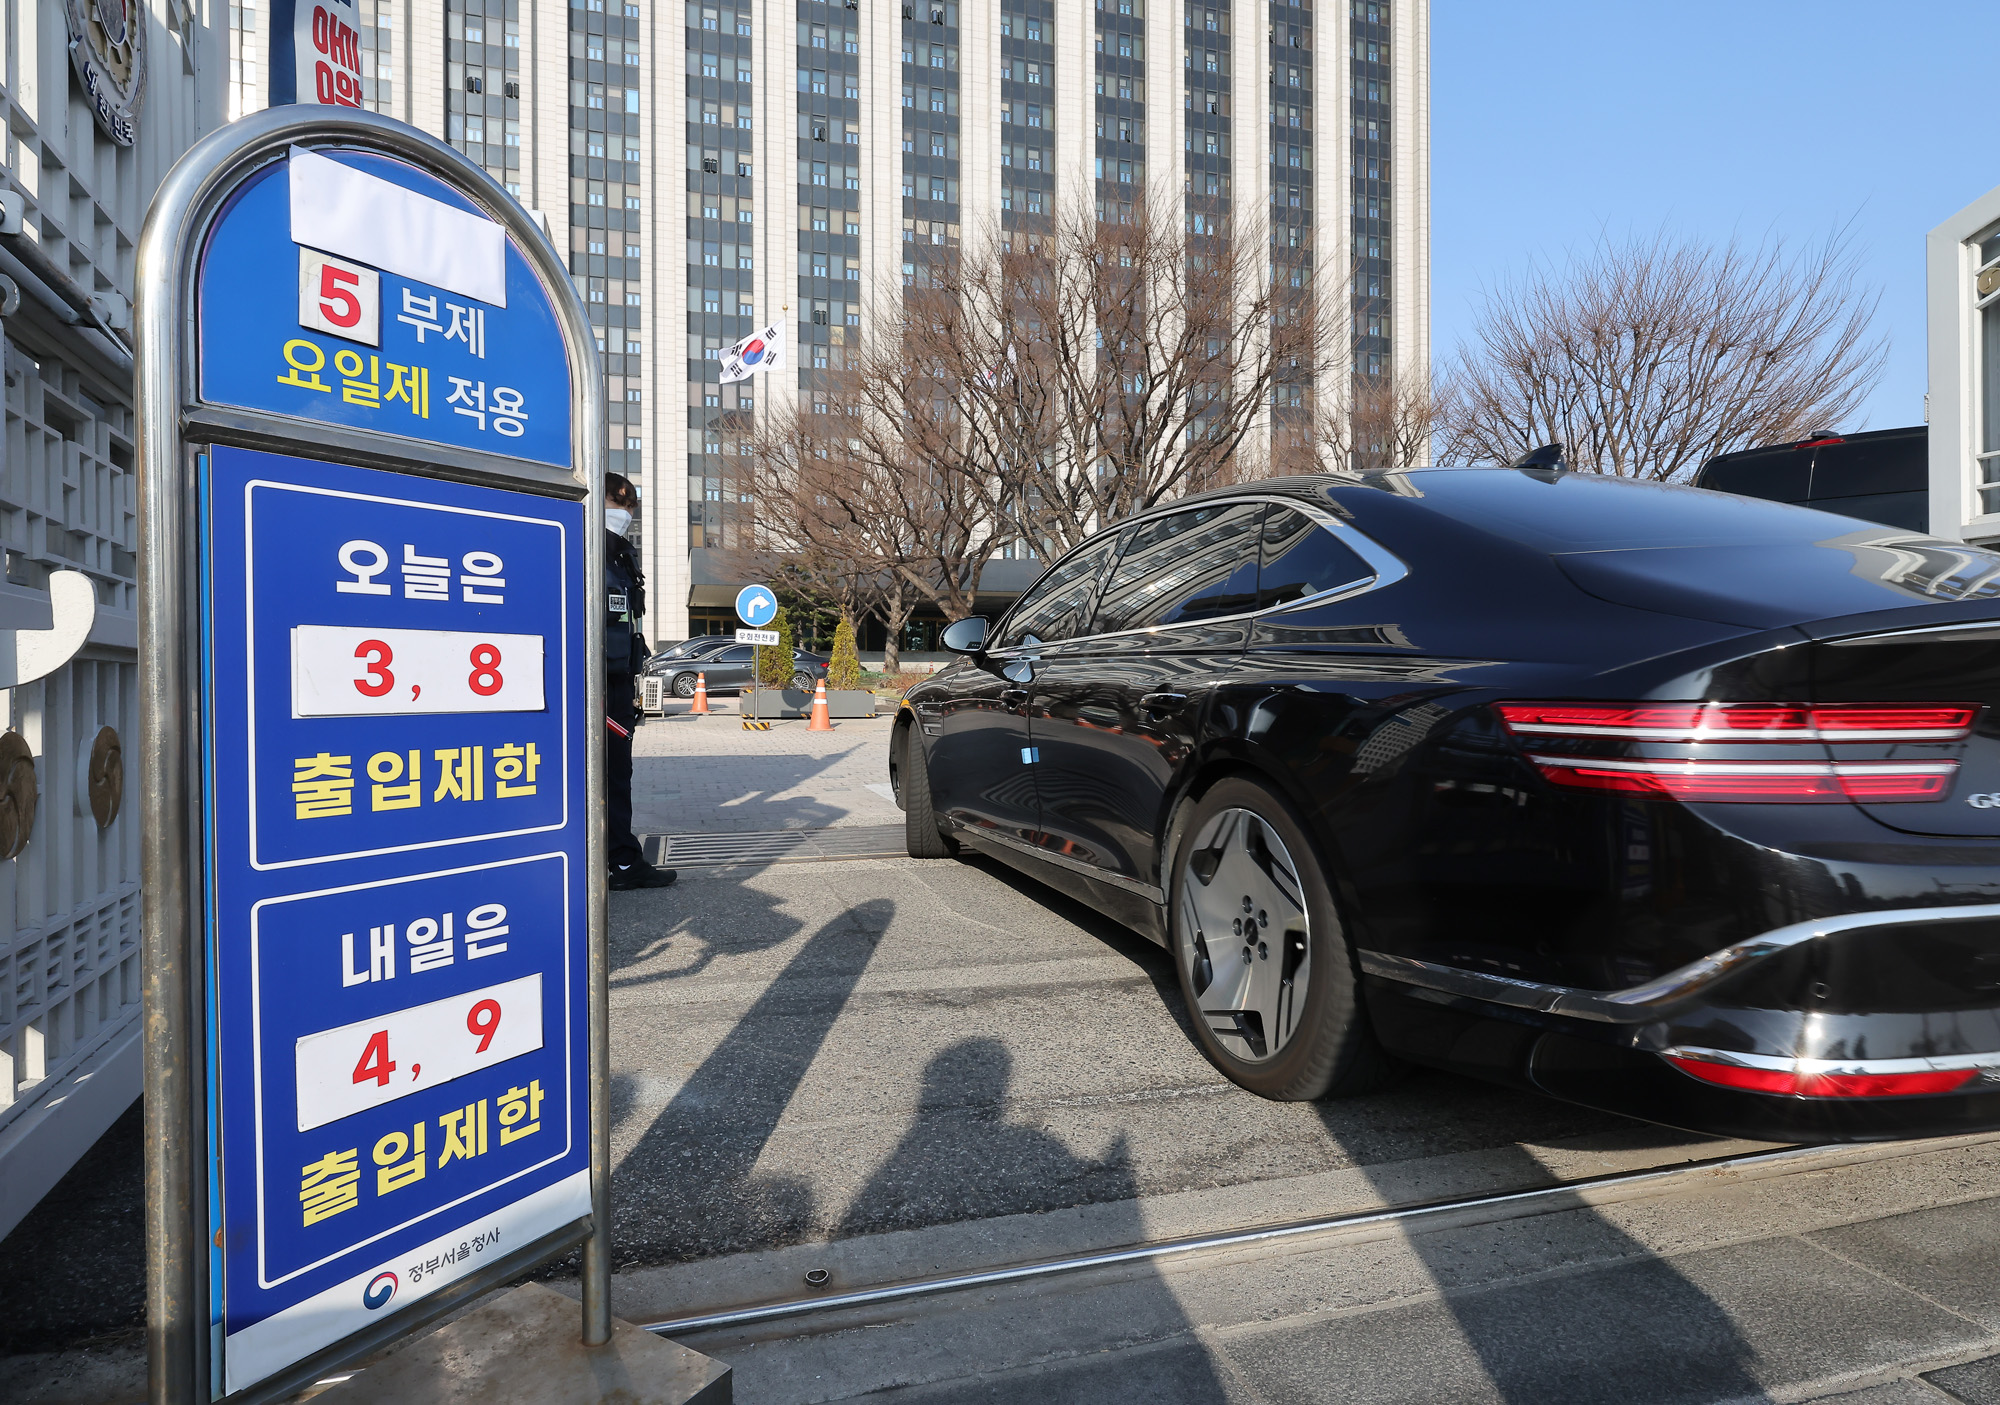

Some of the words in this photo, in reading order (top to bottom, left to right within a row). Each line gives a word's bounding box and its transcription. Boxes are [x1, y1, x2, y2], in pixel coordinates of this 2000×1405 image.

[83, 61, 135, 144] 대한민국
[319, 264, 361, 328] 5
[397, 287, 485, 359] 부제
[277, 339, 429, 419] 요일제
[445, 376, 529, 438] 적용
[336, 539, 506, 605] 오늘은
[468, 643, 504, 697] 8
[291, 742, 541, 820] 출입제한
[341, 903, 509, 988] 내일은
[466, 998, 502, 1054] 9
[299, 1078, 545, 1228] 출입제한
[408, 1226, 501, 1283] 정부서울청사
